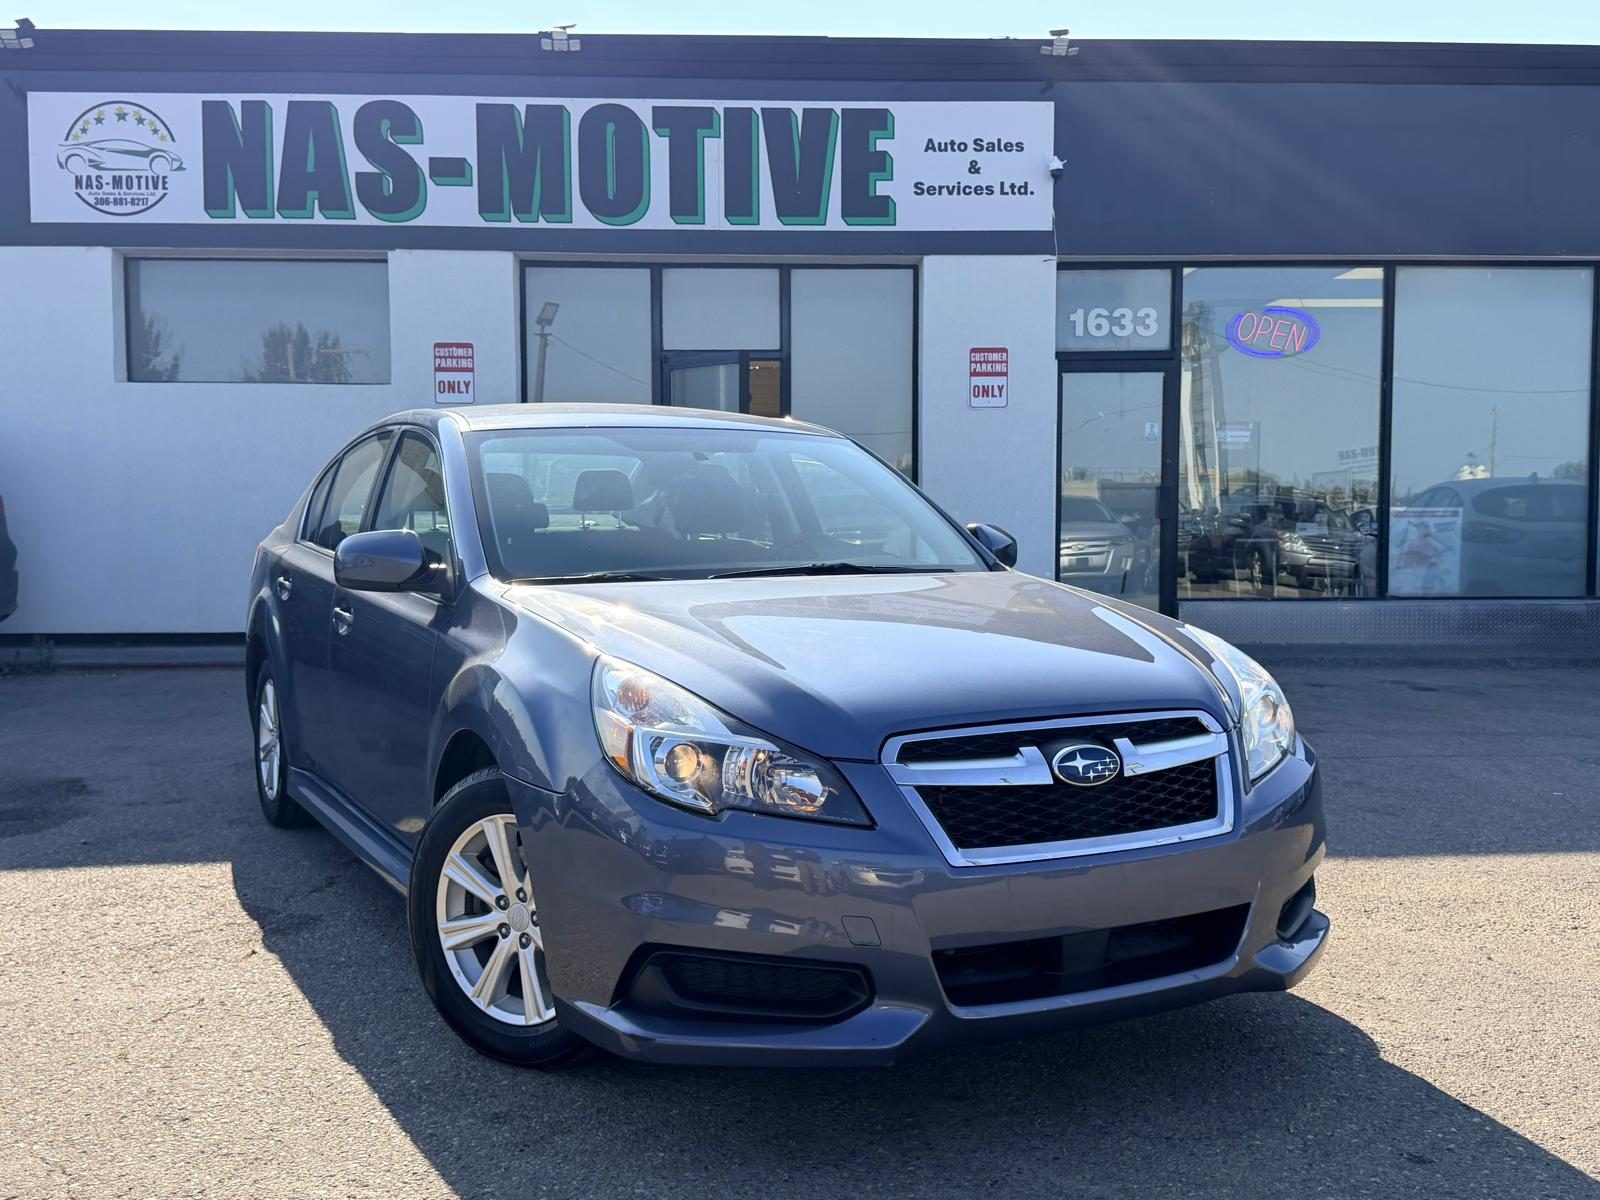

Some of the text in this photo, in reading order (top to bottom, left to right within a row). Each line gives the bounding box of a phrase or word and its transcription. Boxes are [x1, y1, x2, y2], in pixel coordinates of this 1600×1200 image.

[924, 138, 1025, 153] Auto Sales
[201, 100, 897, 227] NAS-MOTIVE
[967, 159, 982, 175] &
[75, 175, 168, 190] NAS-MOTIVE
[913, 181, 1035, 196] Services Ltd.
[1069, 307, 1159, 337] 1633
[1238, 312, 1306, 352] OPEN
[435, 347, 473, 357] CUSTOMER
[971, 352, 1007, 361] CUSTOMER
[435, 358, 473, 368] PARKING
[971, 363, 1007, 372] PARKING
[438, 380, 471, 394] ONLY
[972, 384, 1004, 398] ONLY
